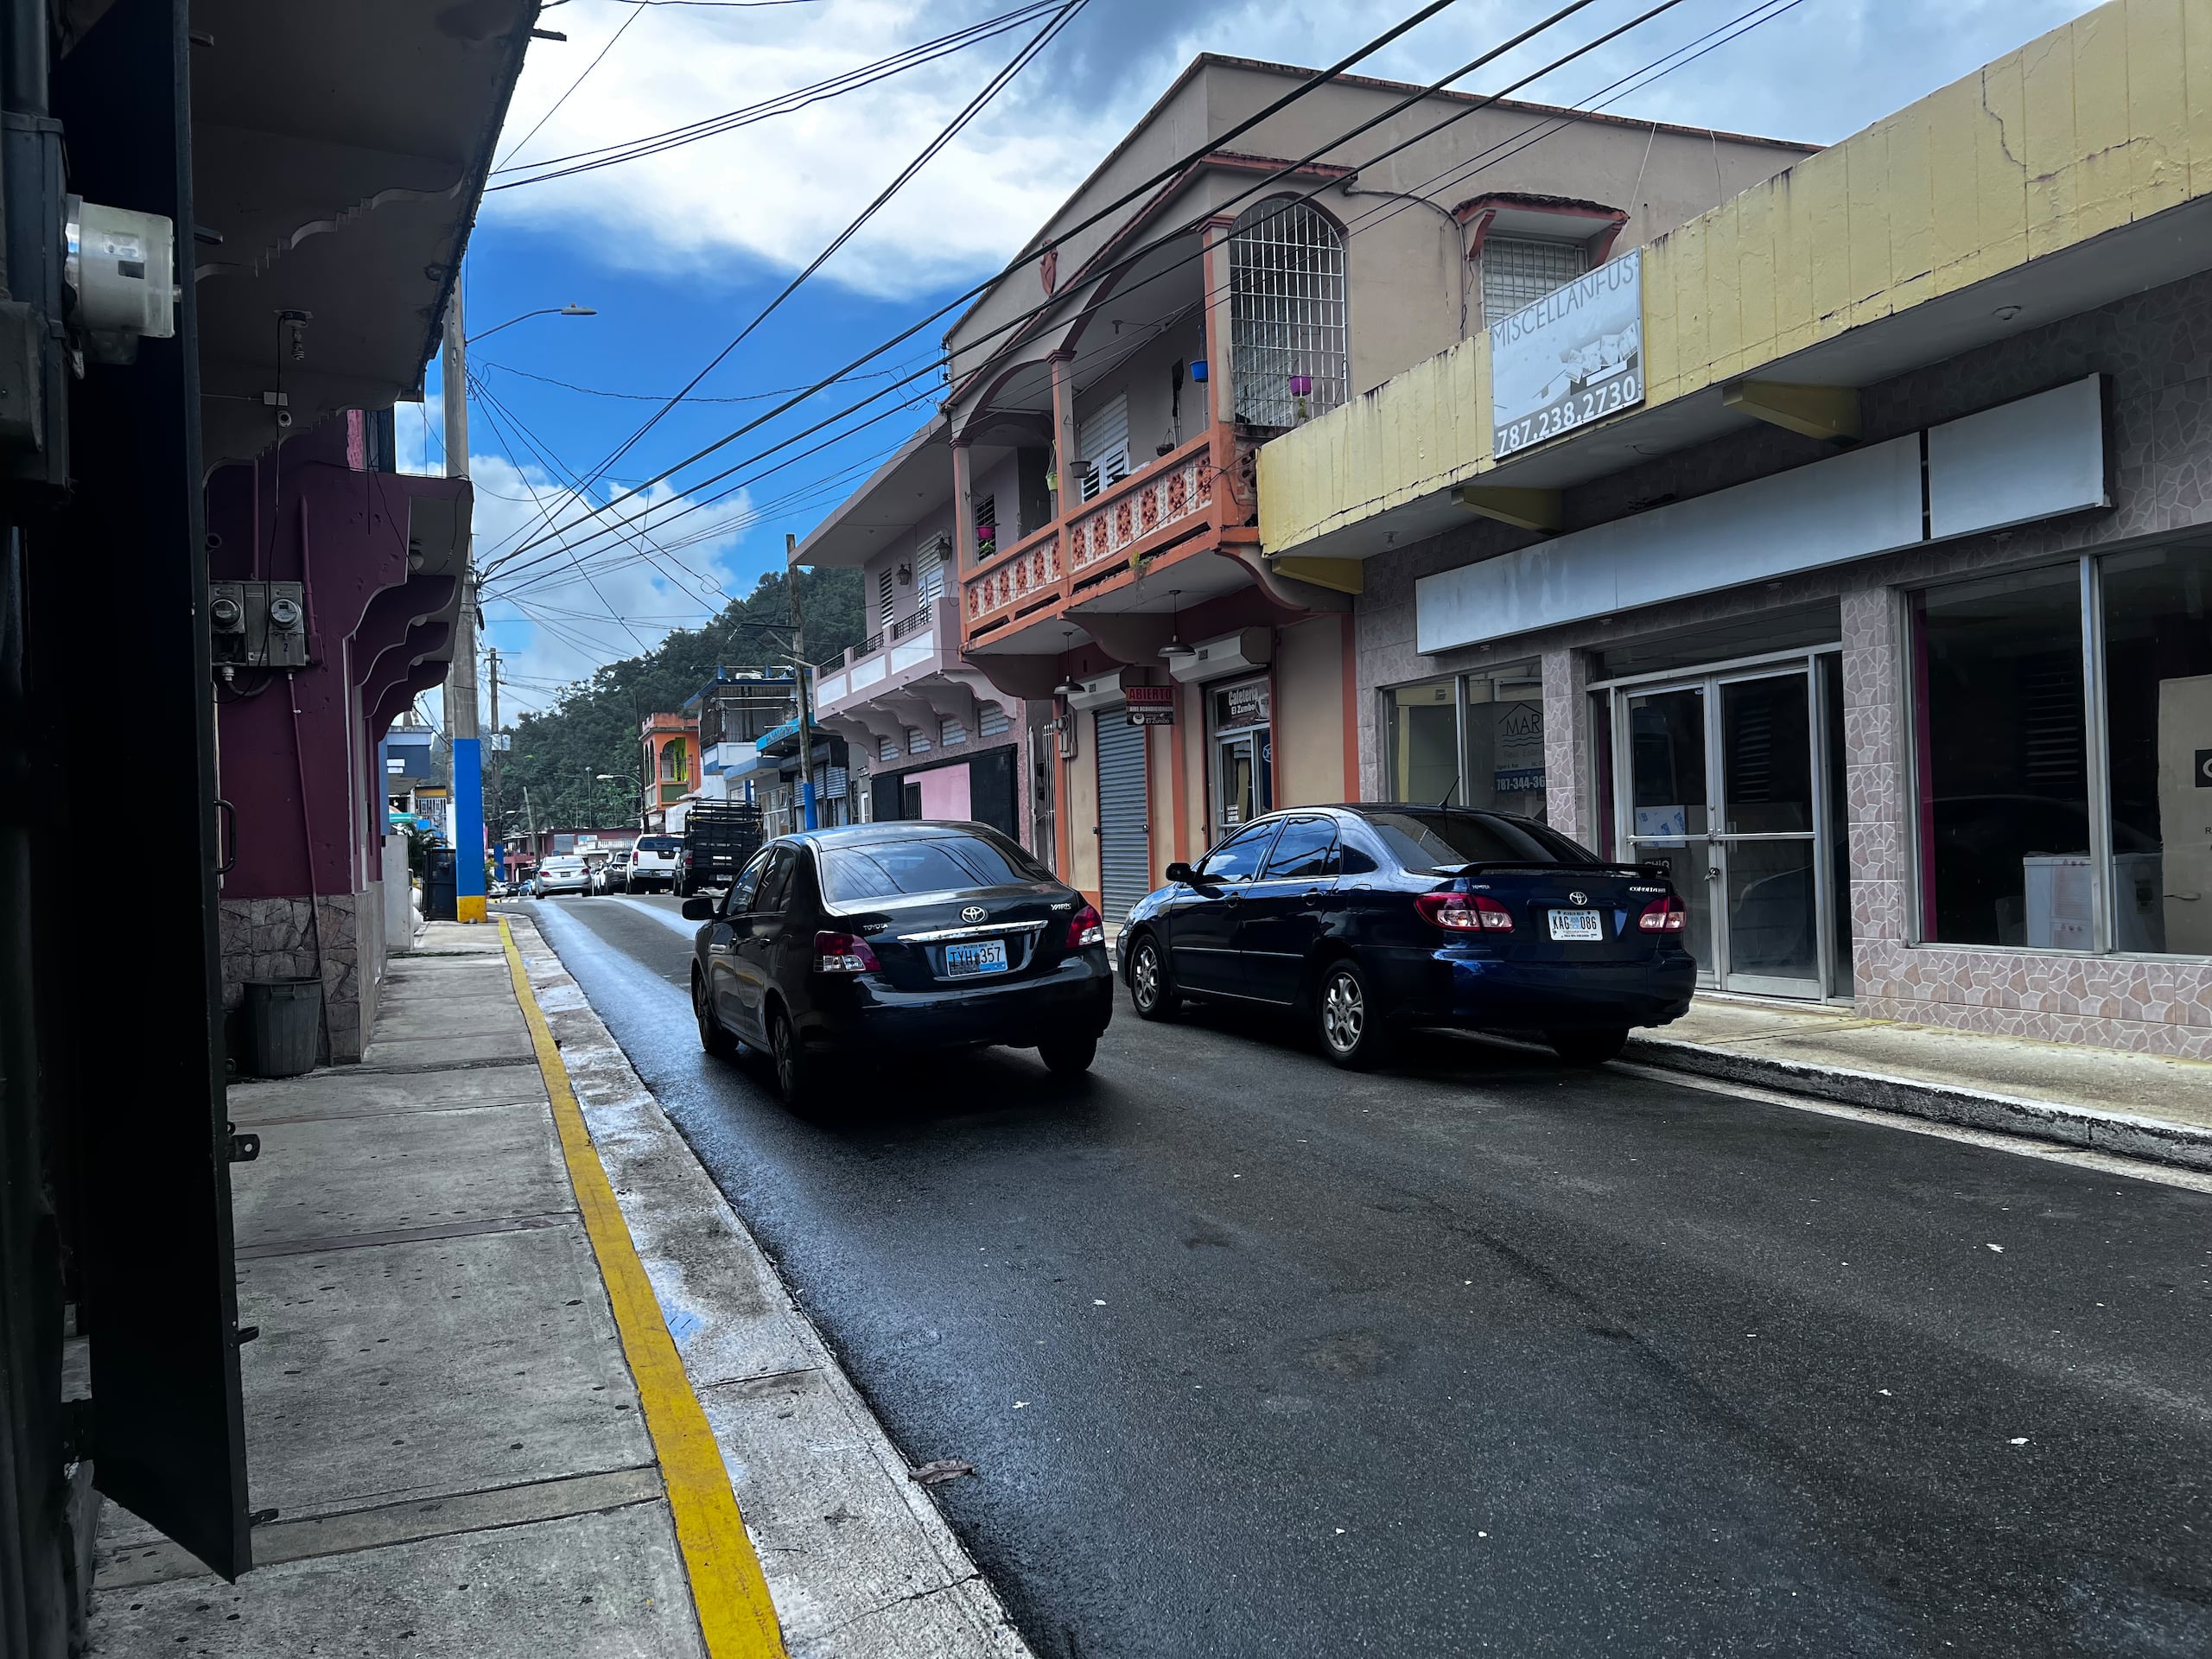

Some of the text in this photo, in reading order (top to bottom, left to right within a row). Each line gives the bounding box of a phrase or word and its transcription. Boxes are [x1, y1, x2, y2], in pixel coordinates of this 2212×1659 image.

[1497, 375, 1636, 454] 787.238.2730
[1128, 688, 1172, 700] ABIERTO
[1231, 702, 1255, 715] El Zumbo
[1506, 714, 1541, 736] MAR
[1553, 916, 1597, 930] KAG 086
[950, 946, 1001, 969] TYH 357
